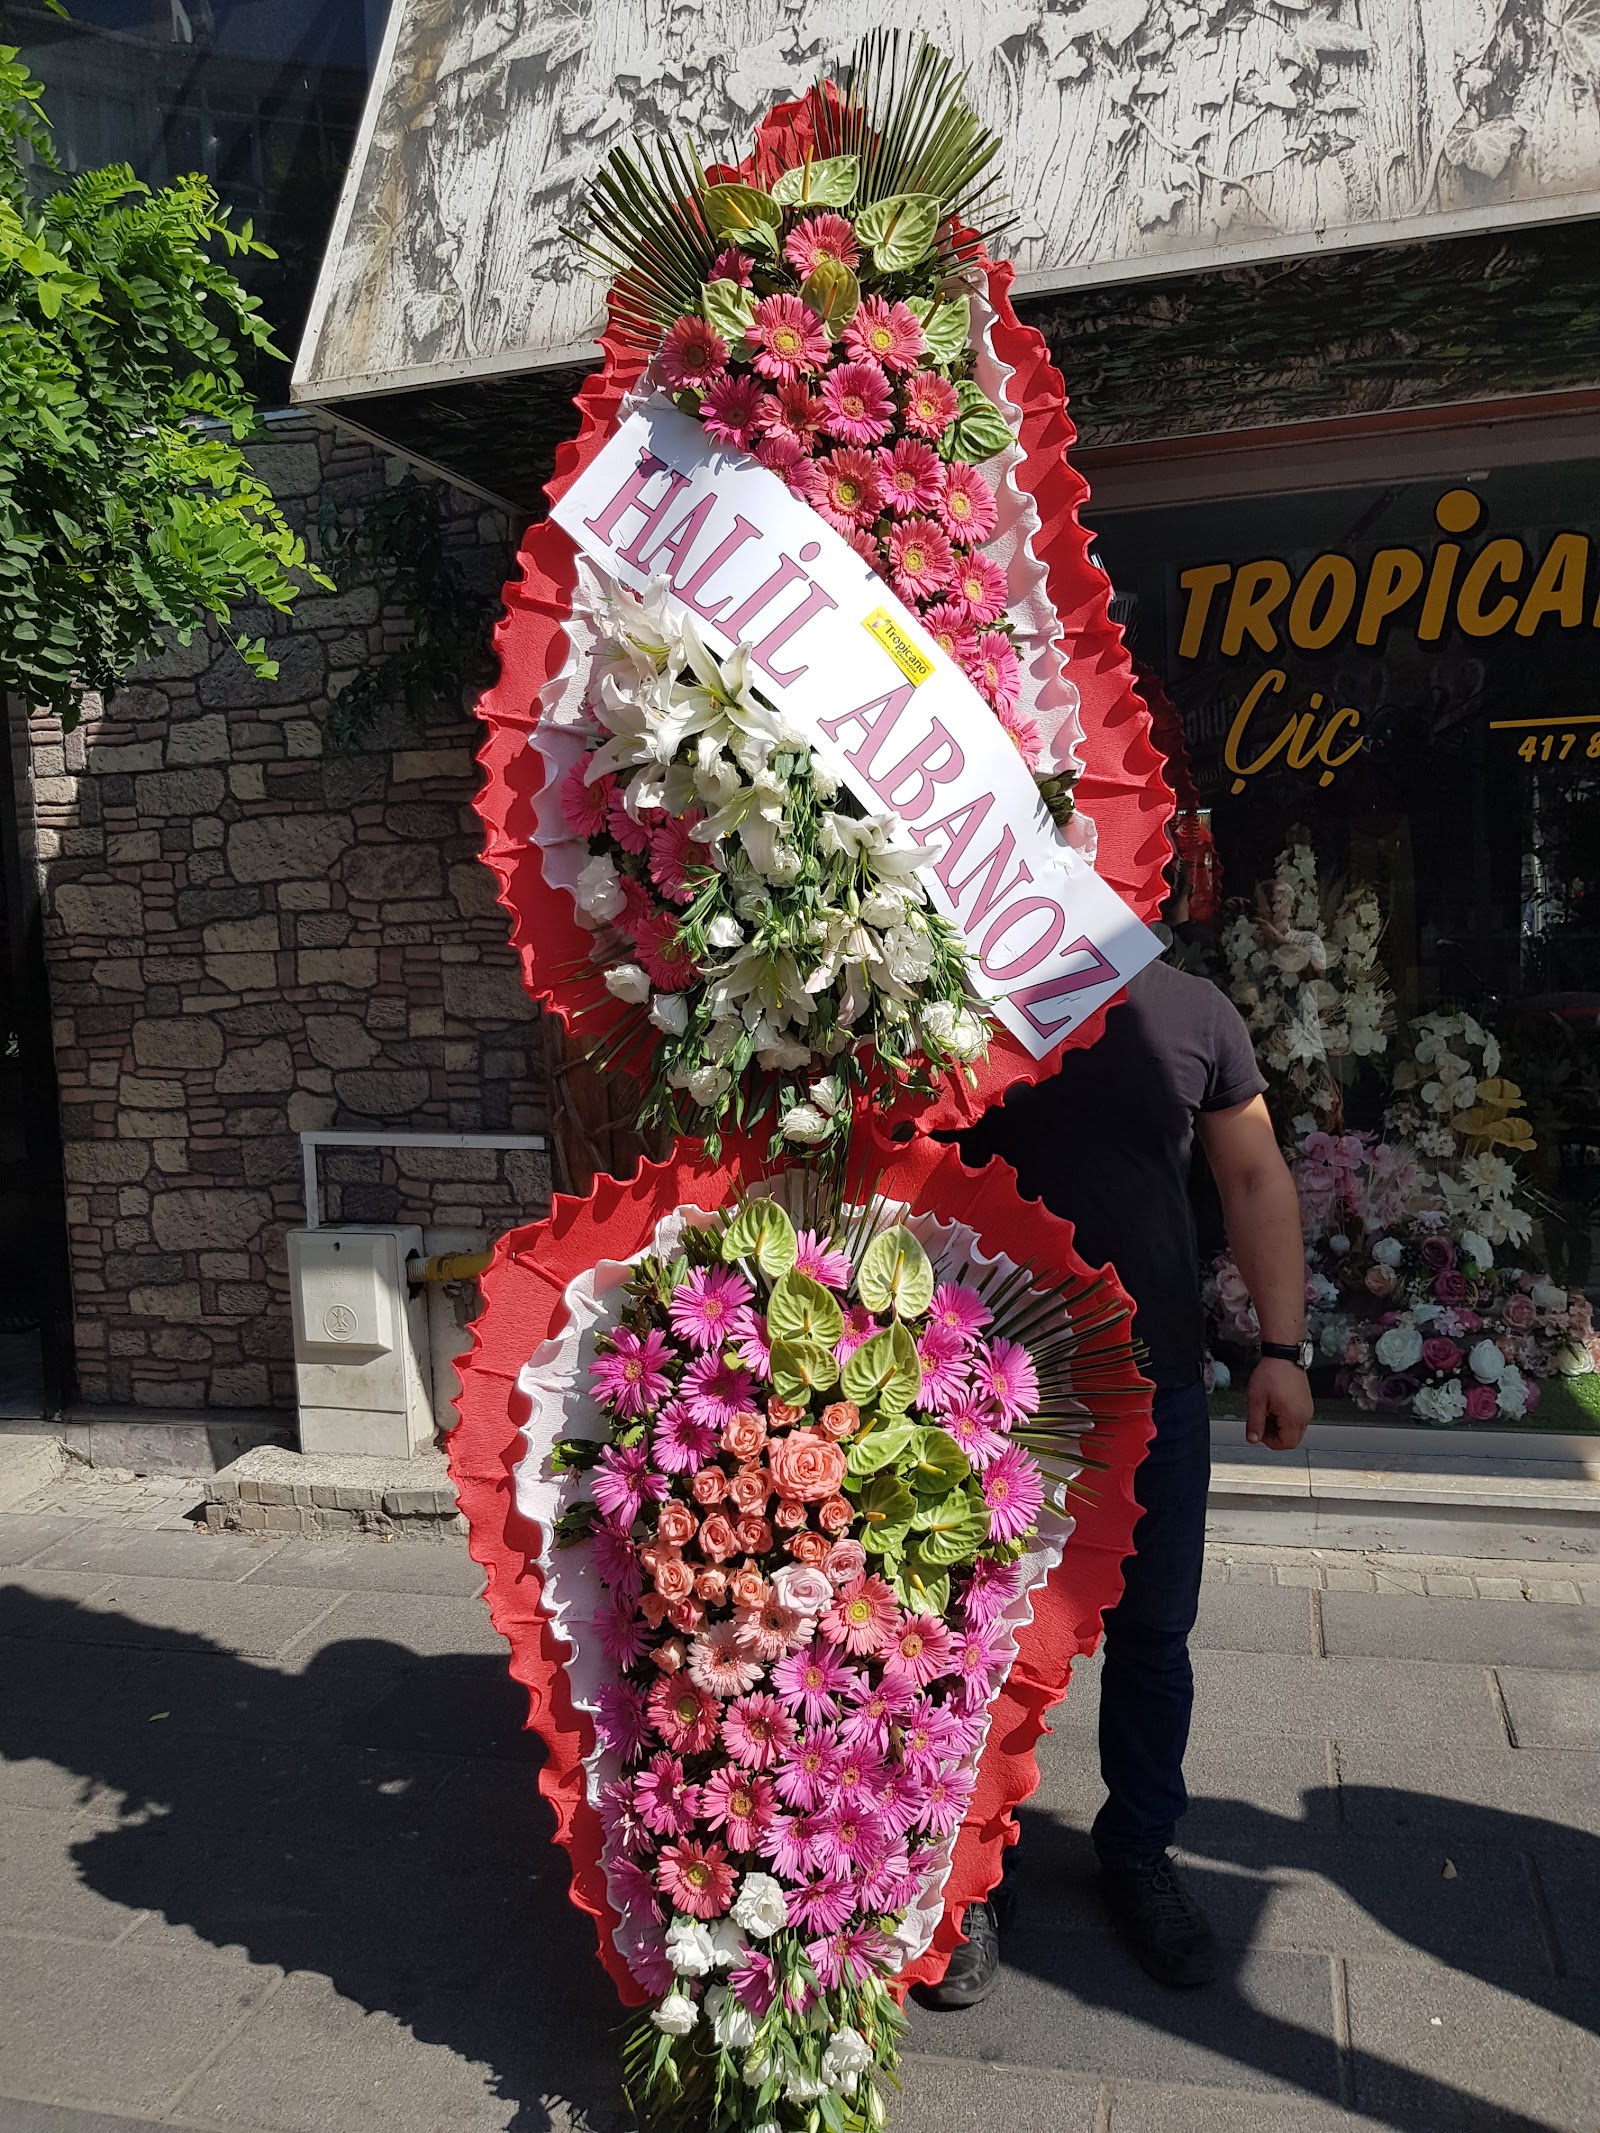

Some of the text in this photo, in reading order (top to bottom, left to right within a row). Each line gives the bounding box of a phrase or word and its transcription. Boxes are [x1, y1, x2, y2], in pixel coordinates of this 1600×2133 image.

[1179, 489, 1600, 659] TROPİCA
[885, 624, 927, 674] Tropicano
[583, 447, 1120, 1039] HALİL ABANOZ
[1225, 669, 1365, 795] Çiç
[1518, 733, 1577, 762] 417
